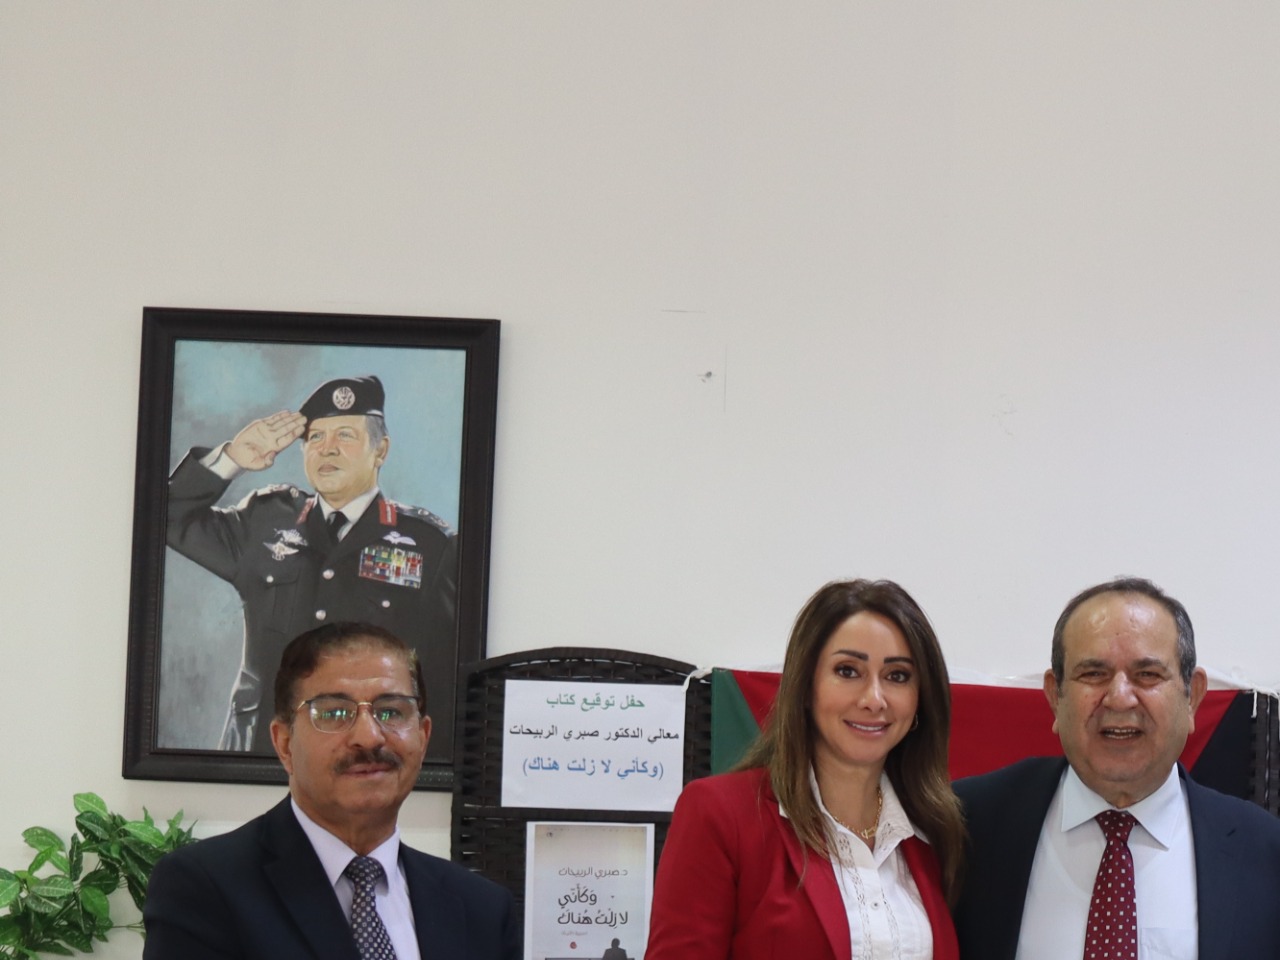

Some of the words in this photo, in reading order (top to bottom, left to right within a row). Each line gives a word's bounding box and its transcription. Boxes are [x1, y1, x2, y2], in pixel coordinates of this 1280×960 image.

[546, 693, 576, 709] كتاب
[580, 692, 616, 712] توقيع
[619, 694, 646, 710] حفل
[509, 724, 558, 740] الربيحات
[563, 728, 600, 742] صبري
[604, 727, 643, 742] الدكتور
[647, 728, 680, 743] معالي
[567, 758, 596, 776] زلت
[601, 759, 612, 775] لا
[619, 910, 629, 925] لا
